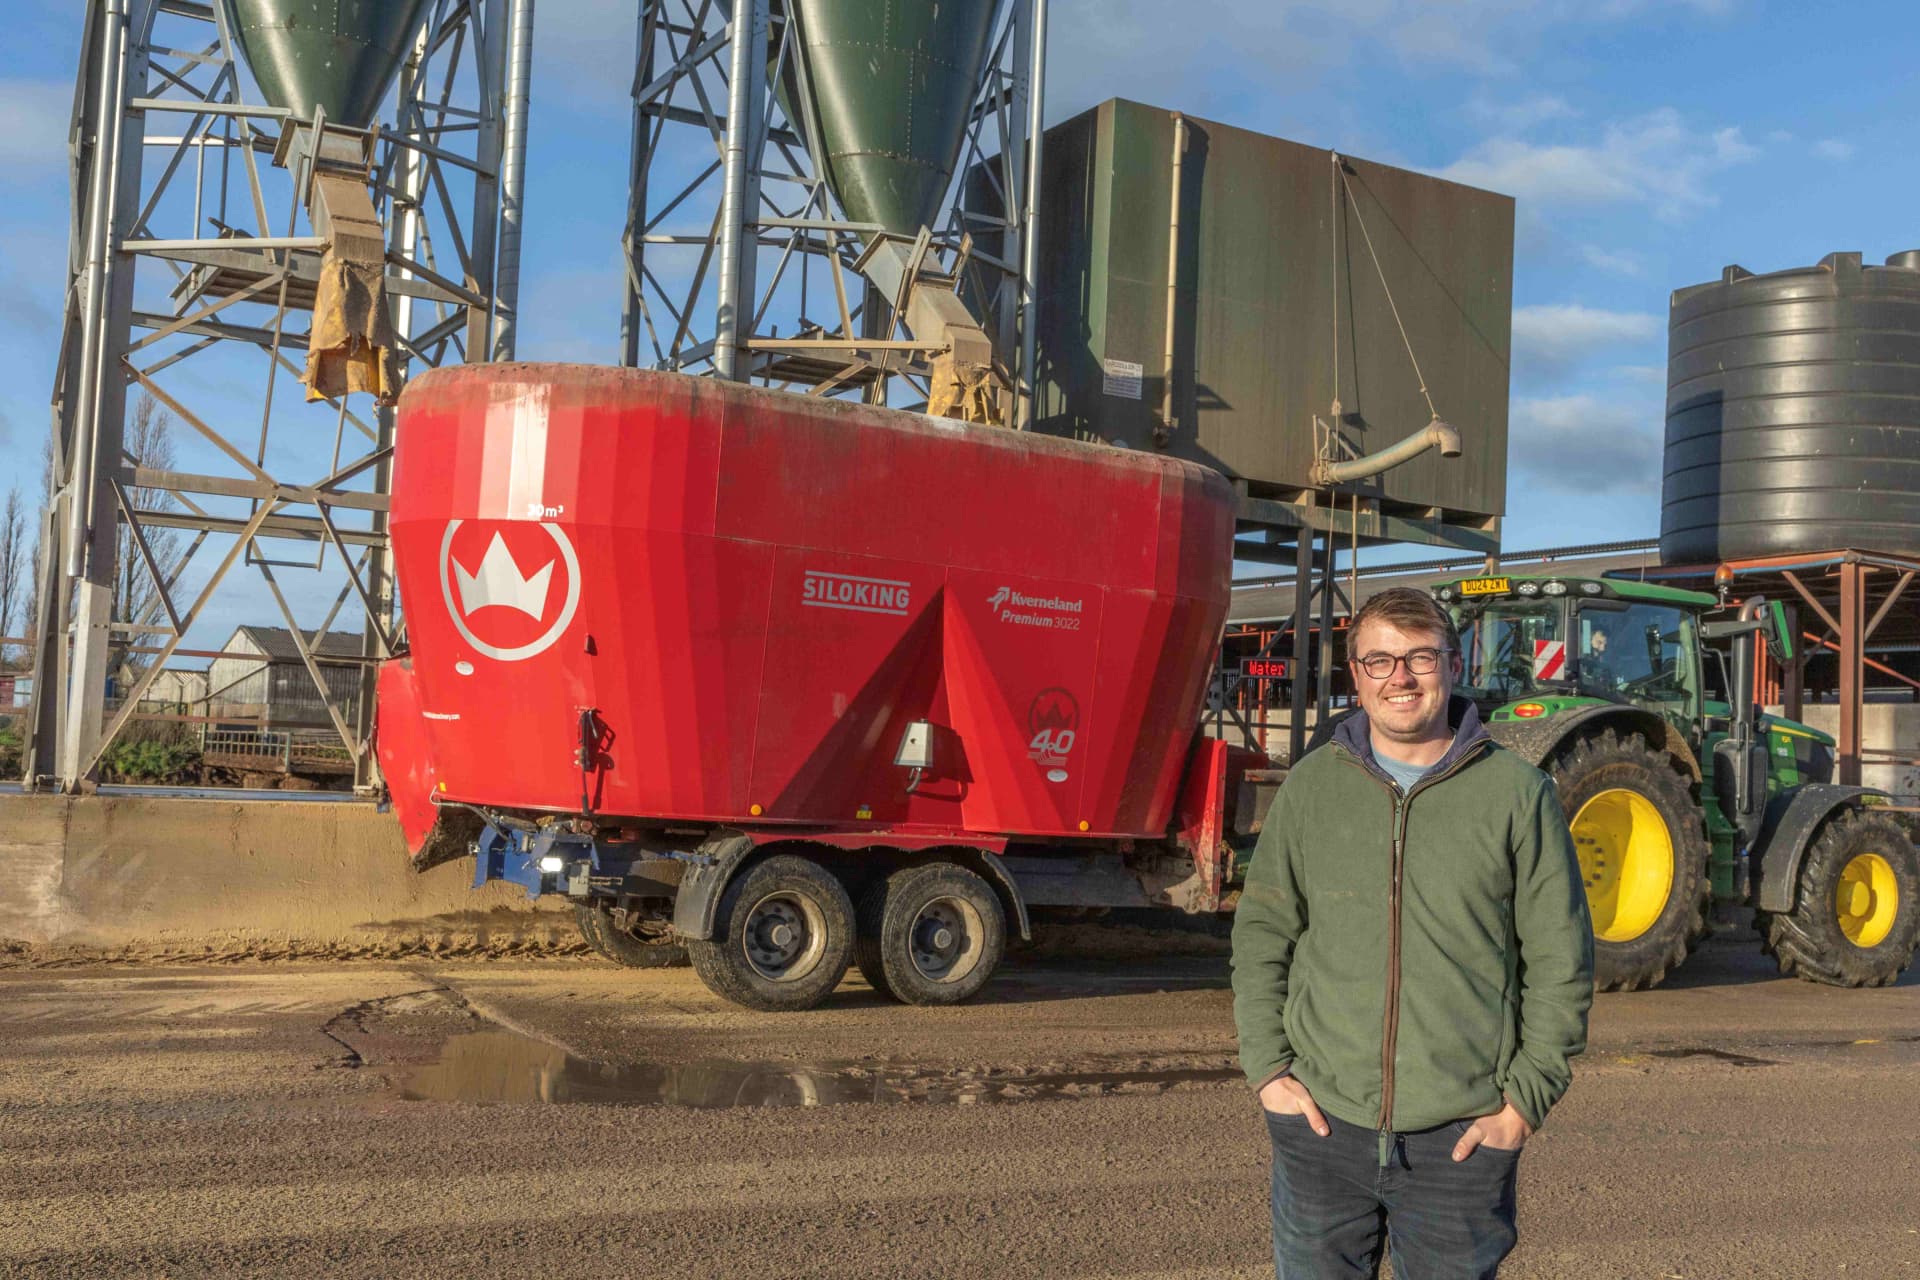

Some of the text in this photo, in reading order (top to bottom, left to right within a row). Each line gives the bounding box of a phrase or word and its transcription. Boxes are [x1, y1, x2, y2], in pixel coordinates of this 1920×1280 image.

[803, 577, 910, 609] SILOKING
[1011, 591, 1082, 613] Kverneland
[1001, 609, 1081, 631] Premium 3022
[1249, 660, 1286, 676] Water
